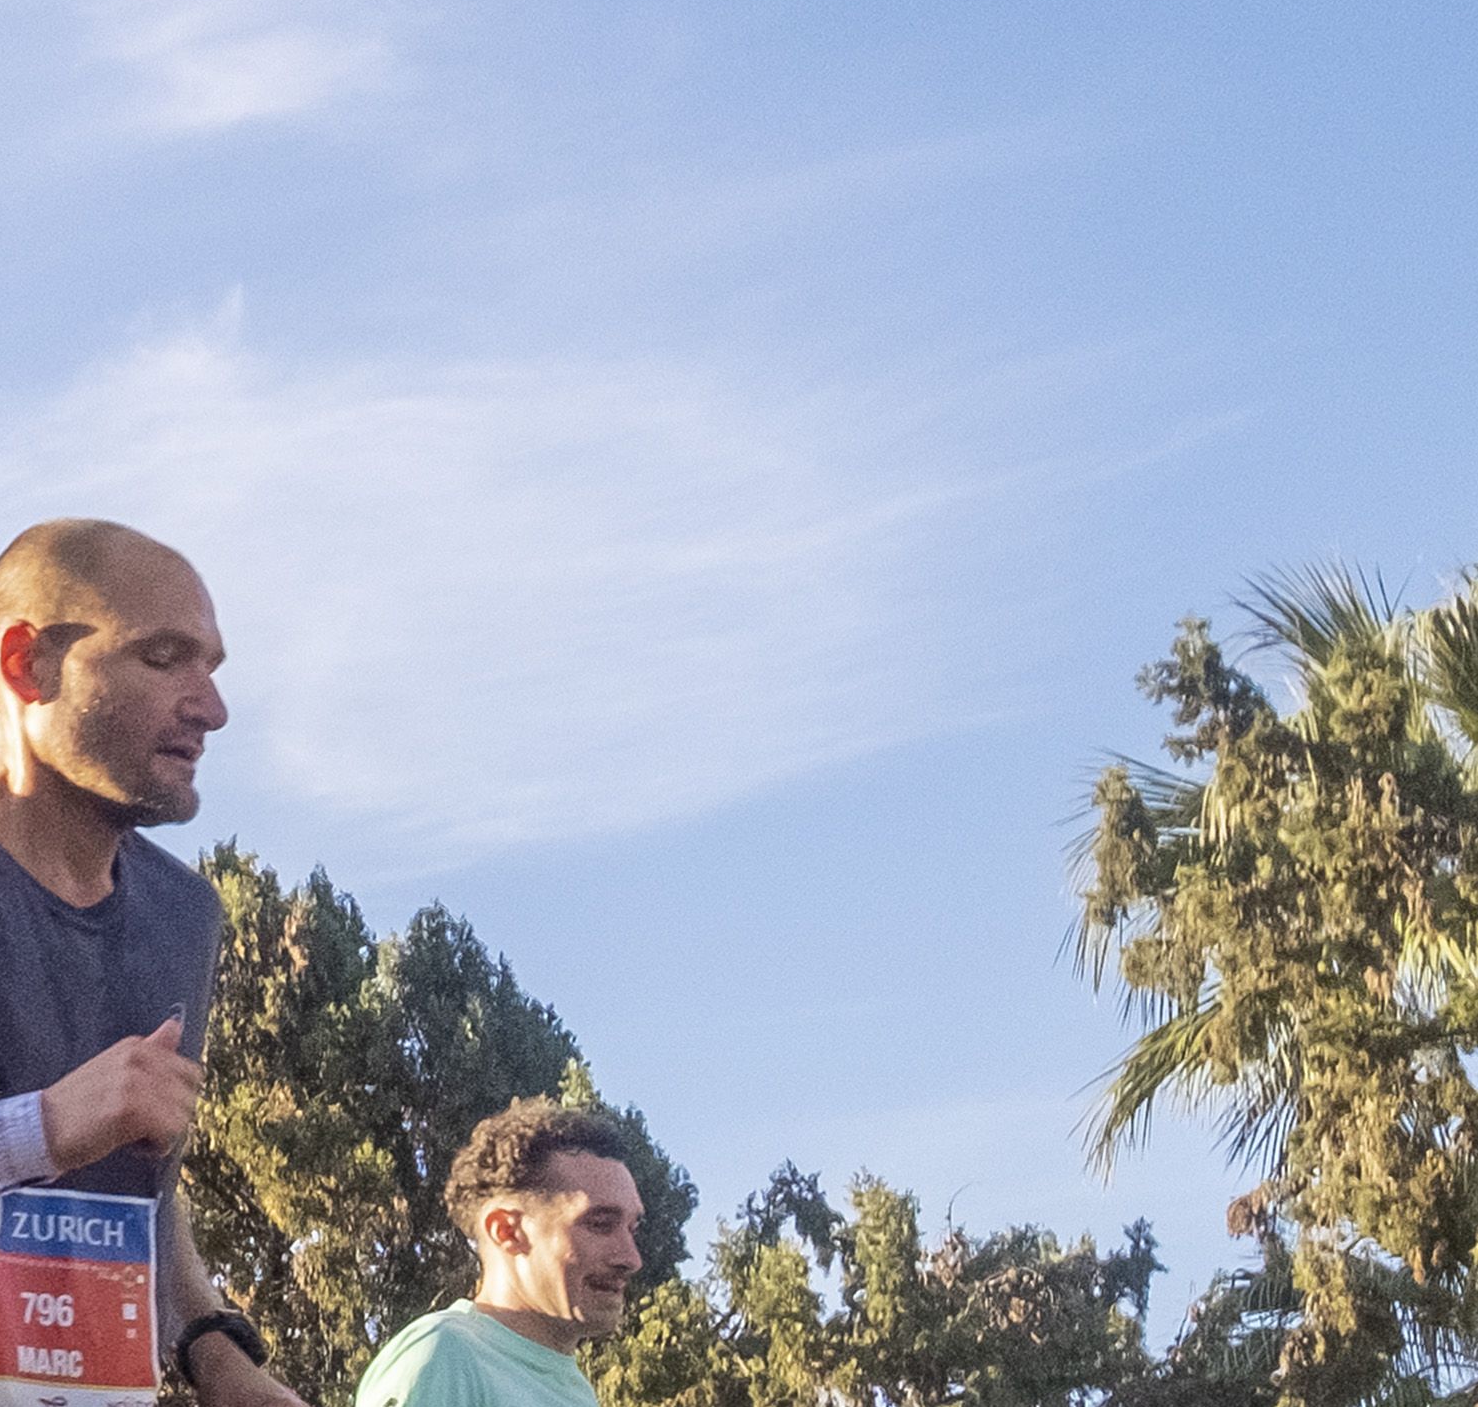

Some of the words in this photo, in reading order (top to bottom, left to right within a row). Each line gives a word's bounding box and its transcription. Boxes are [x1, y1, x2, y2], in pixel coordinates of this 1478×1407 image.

[11, 1211, 125, 1248] ZURICH
[18, 1291, 75, 1328] 796
[16, 1344, 84, 1379] MARC
